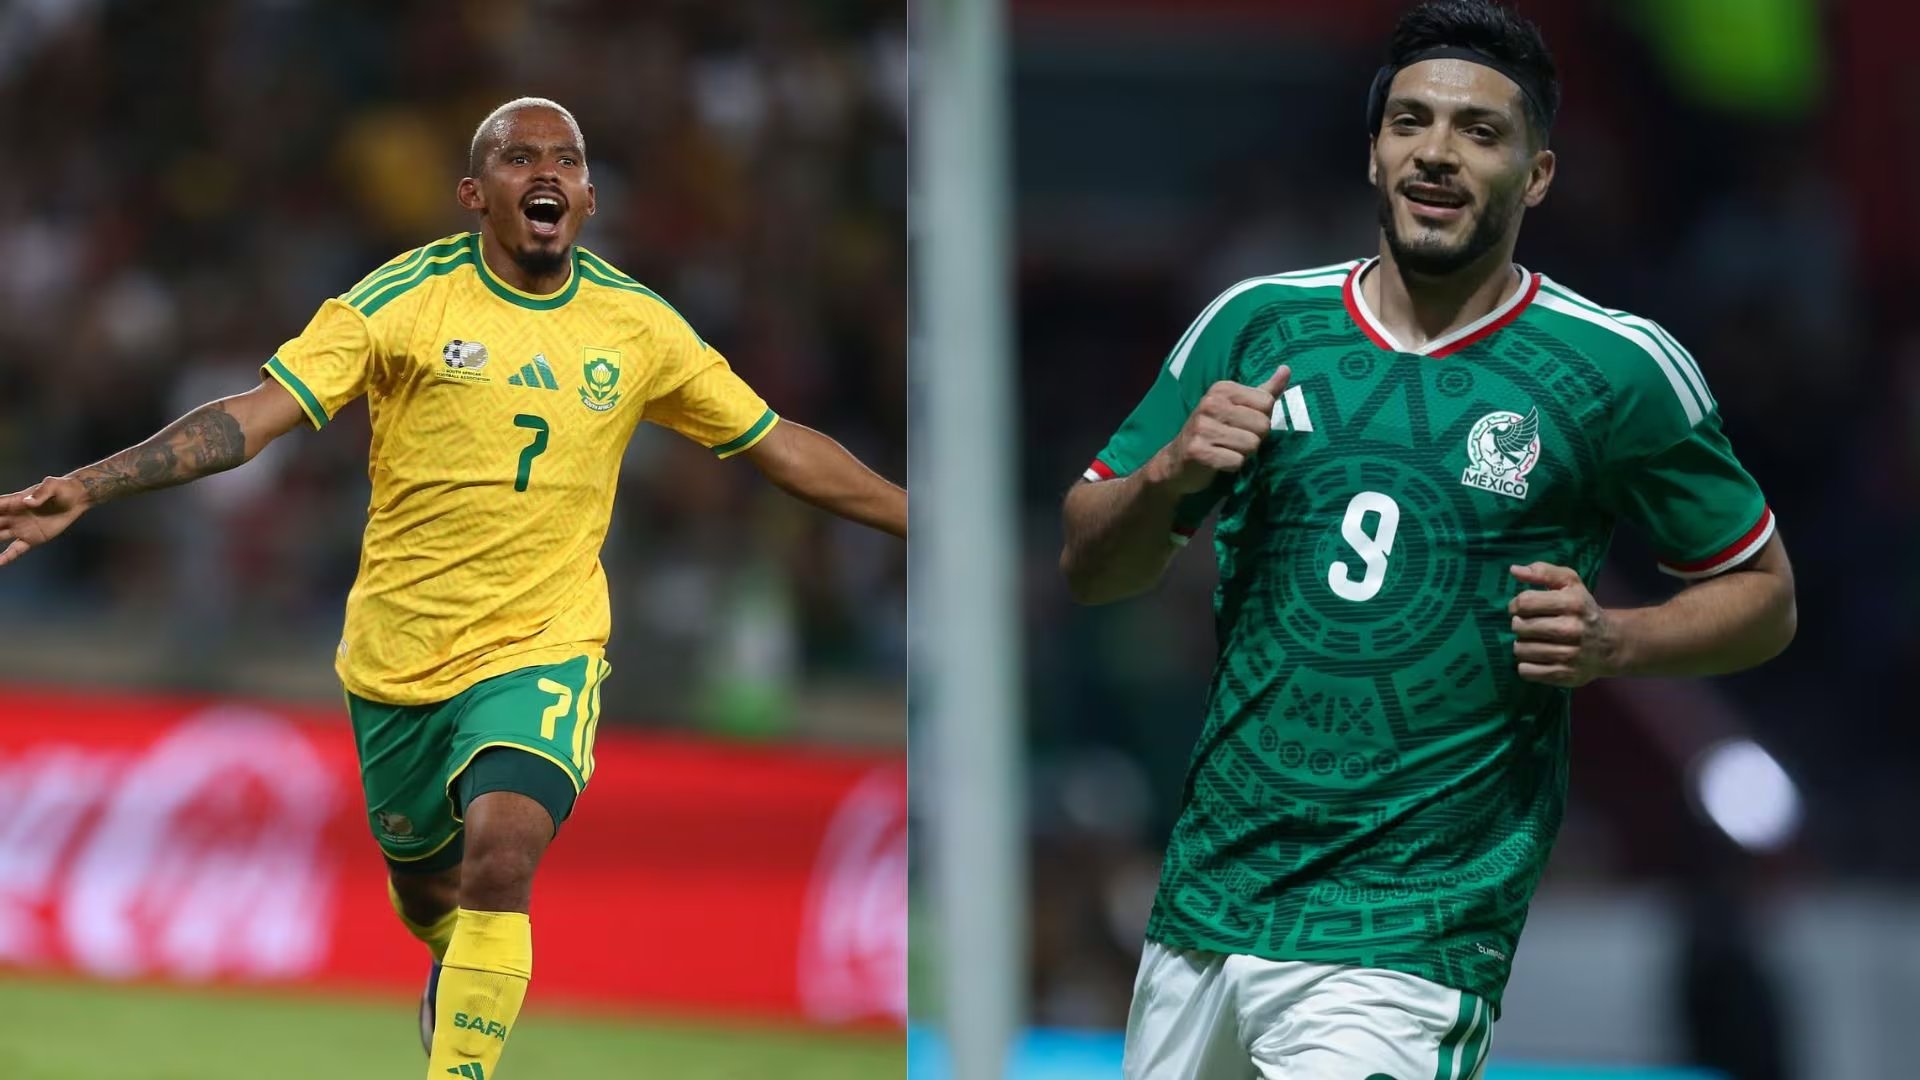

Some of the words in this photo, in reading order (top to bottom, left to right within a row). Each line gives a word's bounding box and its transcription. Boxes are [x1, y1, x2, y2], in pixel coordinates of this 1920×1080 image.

[513, 413, 549, 492] 7
[1463, 471, 1526, 497] MÉXICO
[1328, 491, 1400, 602] 9
[537, 677, 573, 741] 7
[454, 1012, 507, 1042] SAFA
